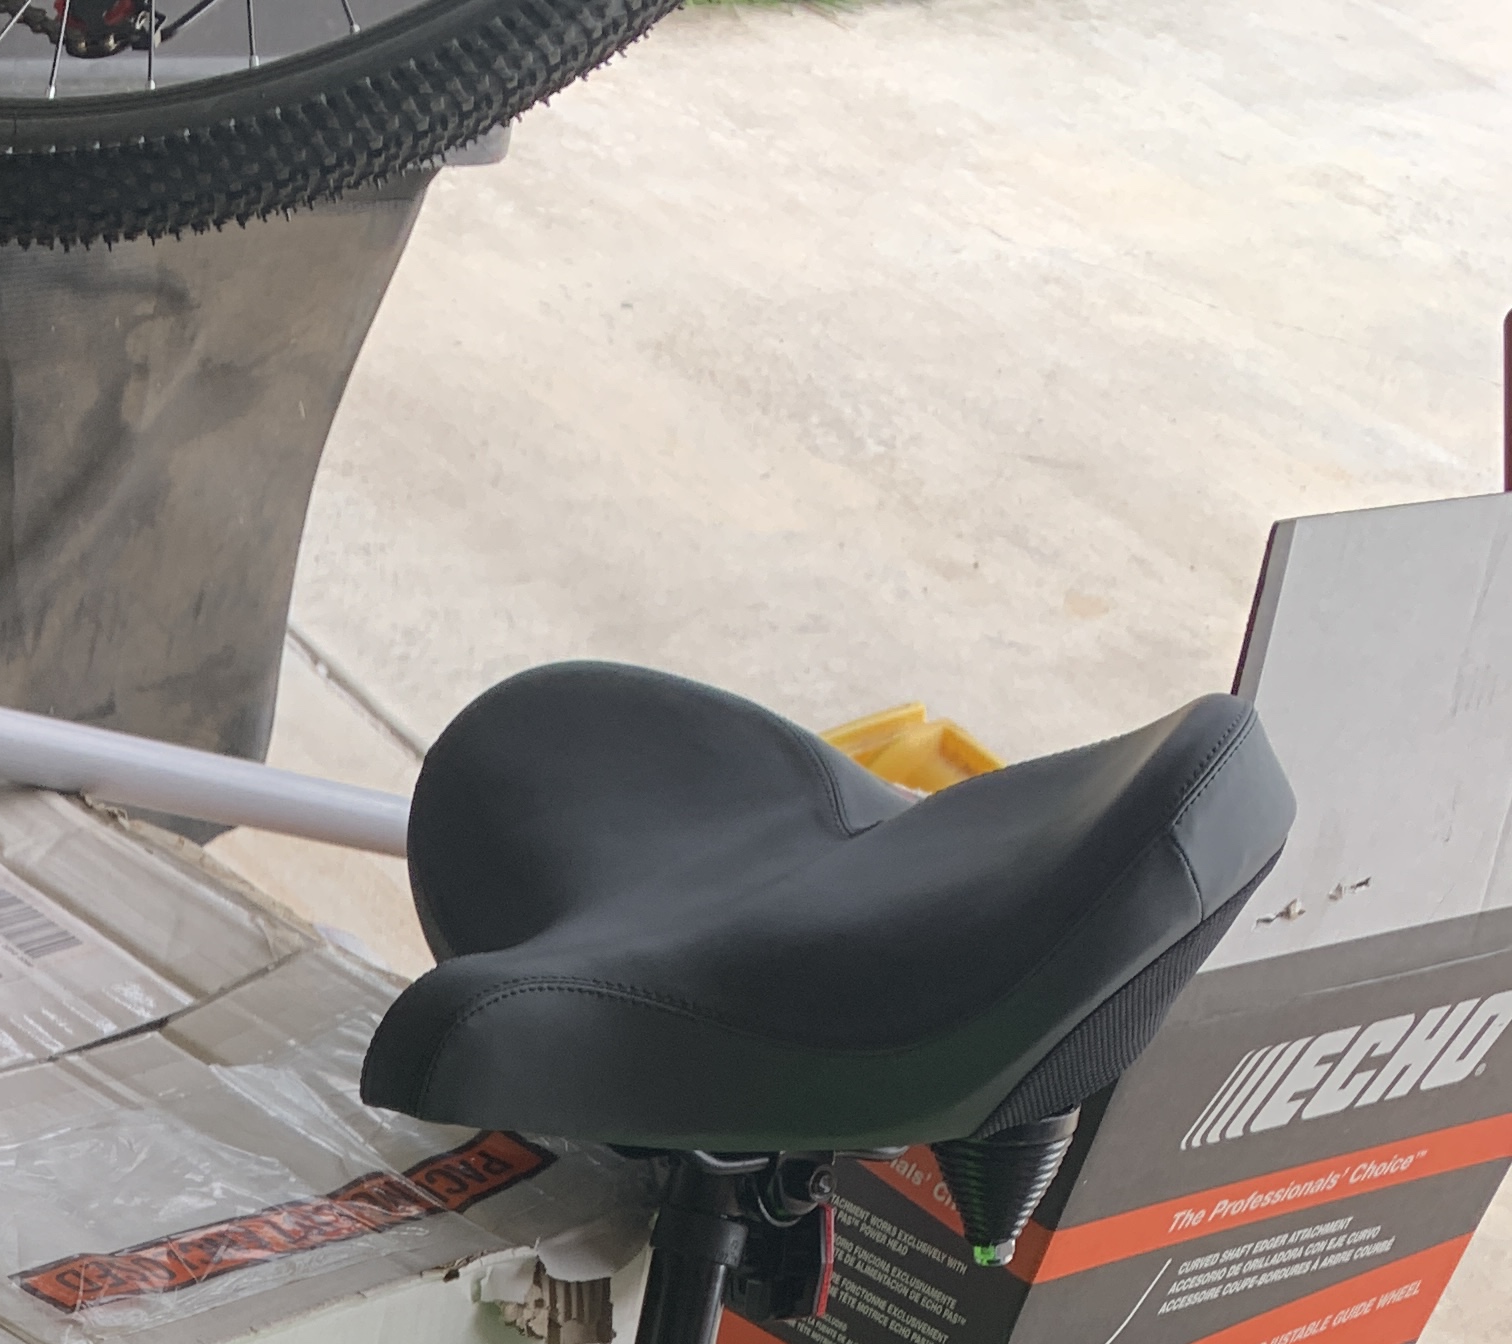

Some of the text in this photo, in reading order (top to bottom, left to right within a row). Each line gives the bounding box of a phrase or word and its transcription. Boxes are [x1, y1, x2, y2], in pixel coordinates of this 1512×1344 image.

[1168, 1209, 1206, 1233] The
[886, 1237, 909, 1256] HEAD
[897, 1229, 948, 1263] EXCLUSIVELY
[947, 1255, 968, 1275] WITH
[1178, 1252, 1221, 1275] CURVED
[1219, 1243, 1254, 1265] SHAFT
[1226, 1263, 1242, 1277] DE
[1332, 1297, 1377, 1327] GUIDE
[1376, 1280, 1422, 1310] WHEEL
